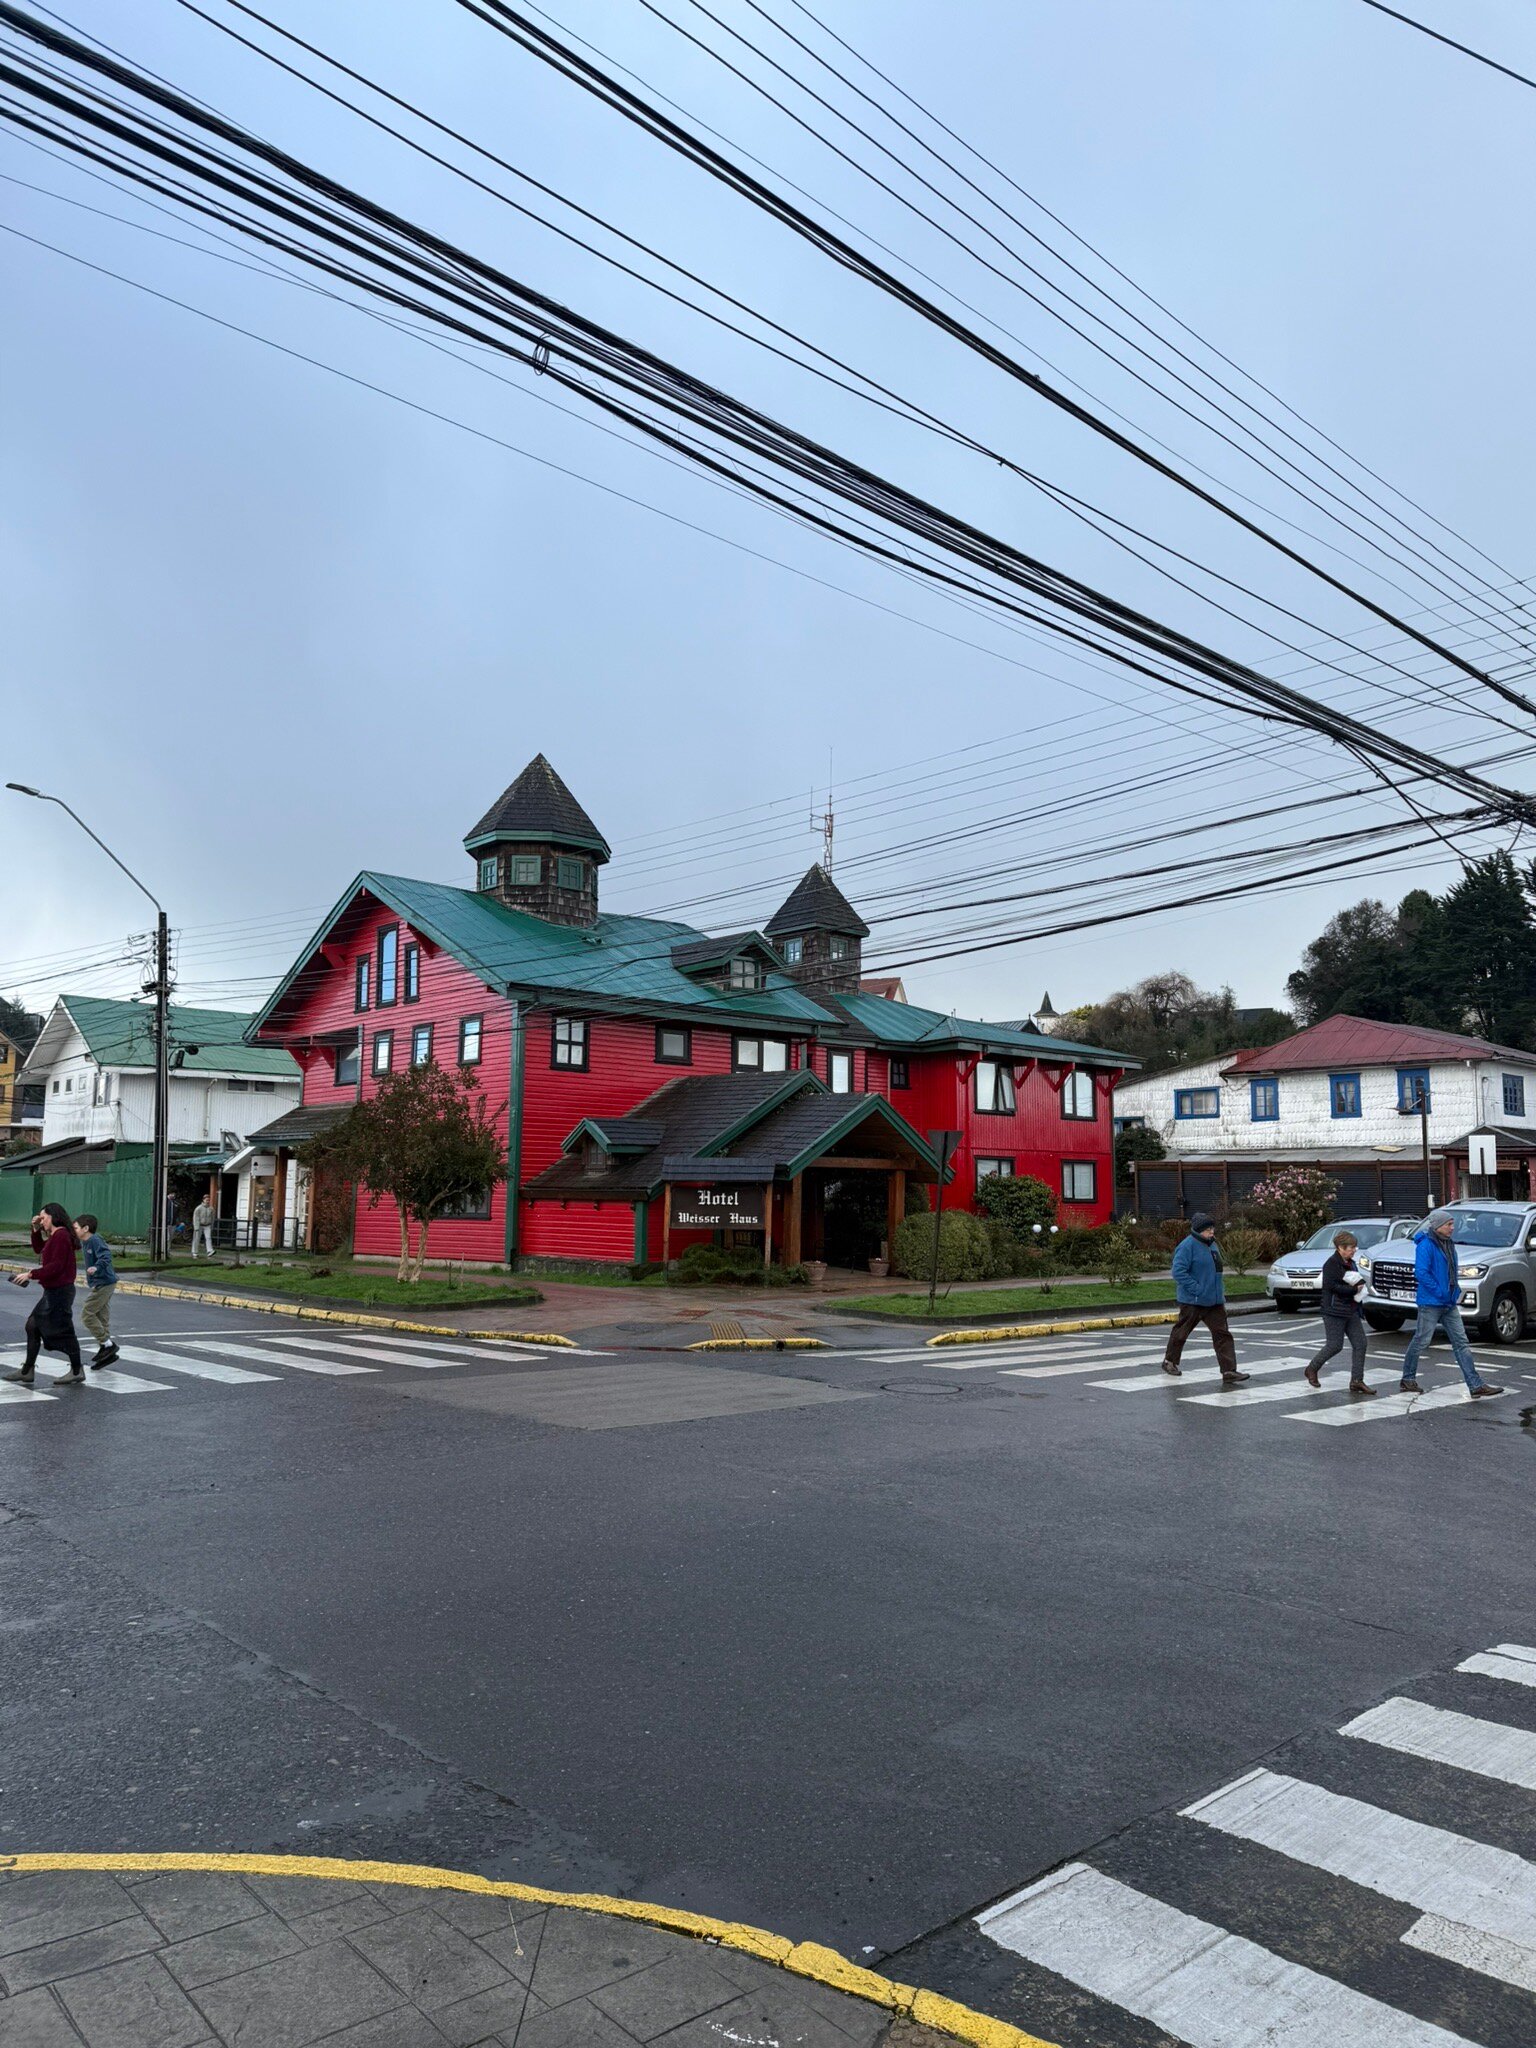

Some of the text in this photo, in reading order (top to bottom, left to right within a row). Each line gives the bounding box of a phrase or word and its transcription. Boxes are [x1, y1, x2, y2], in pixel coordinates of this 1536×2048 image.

[698, 1190, 739, 1205] Hotel
[678, 1212, 758, 1224] Weisser Haus
[1383, 1265, 1416, 1273] MAXU
